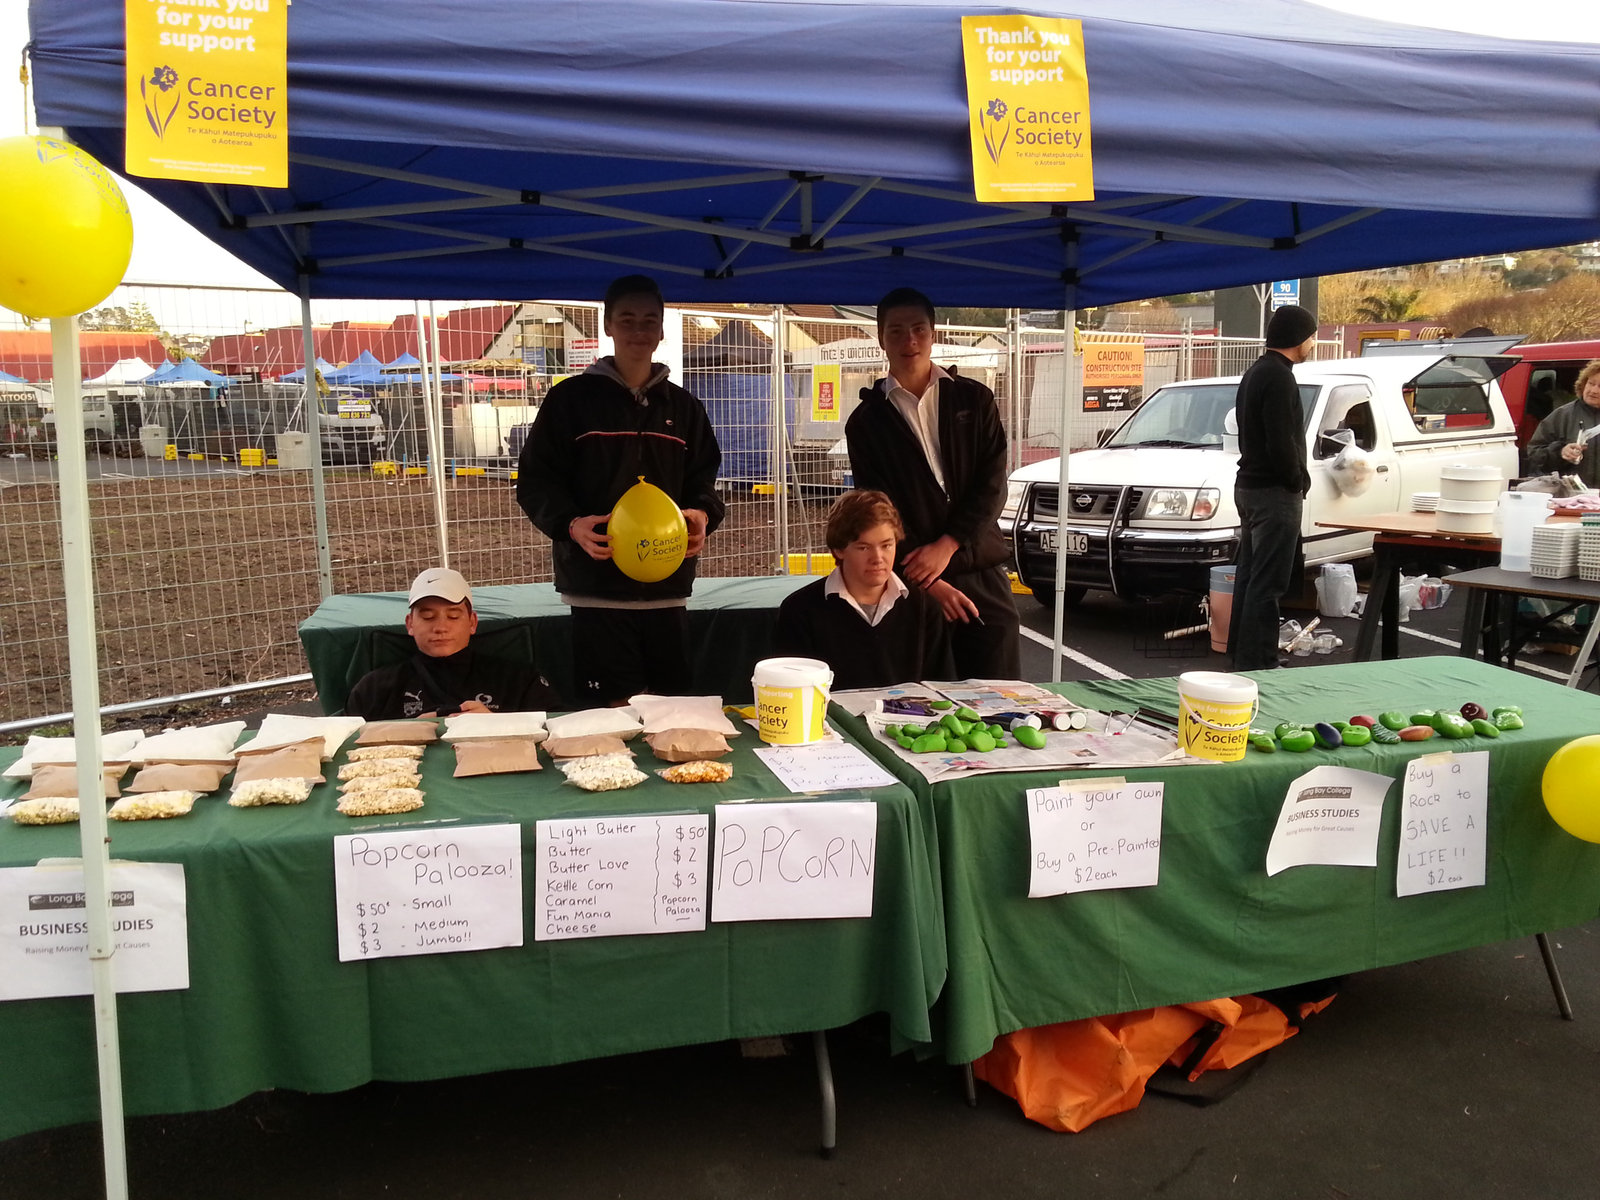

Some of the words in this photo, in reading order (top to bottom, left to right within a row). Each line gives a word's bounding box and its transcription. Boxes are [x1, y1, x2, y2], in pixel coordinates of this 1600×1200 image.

[157, 6, 192, 26] for
[199, 14, 253, 32] your
[160, 32, 255, 52] support
[975, 26, 1035, 44] Thank
[1039, 31, 1070, 47] you
[986, 47, 1014, 63] for
[1018, 49, 1061, 66] your
[990, 67, 1064, 86] support
[187, 77, 275, 100] Cancer
[188, 101, 276, 129] Society
[1015, 107, 1081, 124] Cancer
[1015, 128, 1082, 149] Society
[1280, 283, 1291, 293] 90
[1097, 350, 1133, 361] CAUTION!
[1085, 364, 1130, 372] CONSTRUCTION
[652, 534, 681, 547] Cancer
[652, 544, 682, 556] Society
[1204, 731, 1246, 744] Society
[1409, 764, 1434, 787] Buy
[1451, 764, 1460, 774] a
[1035, 789, 1073, 813] Paint
[1085, 791, 1122, 811] your
[1457, 789, 1471, 800] to
[1320, 808, 1360, 818] STUDIES
[1080, 821, 1095, 831] or
[1407, 817, 1451, 840] SAVE
[1466, 815, 1475, 829] A
[549, 825, 587, 845] Light
[596, 822, 637, 835] Butter
[350, 837, 460, 869] Popcorn
[548, 846, 592, 857] Butter
[549, 861, 590, 874] Butter
[599, 859, 629, 871] Love
[1036, 852, 1061, 872] Buy
[1068, 852, 1076, 863] a
[414, 858, 513, 886] Palooza!
[1094, 870, 1117, 880] each
[546, 879, 578, 893] Kettle
[587, 879, 613, 891] Corn
[49, 895, 73, 904] Long
[412, 894, 452, 910] Small
[545, 895, 597, 907] Caramel
[661, 894, 698, 906] Popcorn
[546, 909, 570, 921] Fun
[574, 911, 612, 920] Mania
[665, 906, 701, 917] Palooza
[112, 919, 154, 932] UDIES
[414, 919, 469, 933] Medium
[546, 923, 597, 936] Cheese
[25, 947, 54, 955] Raising
[55, 944, 84, 953] Money
[123, 942, 150, 950] Causes
